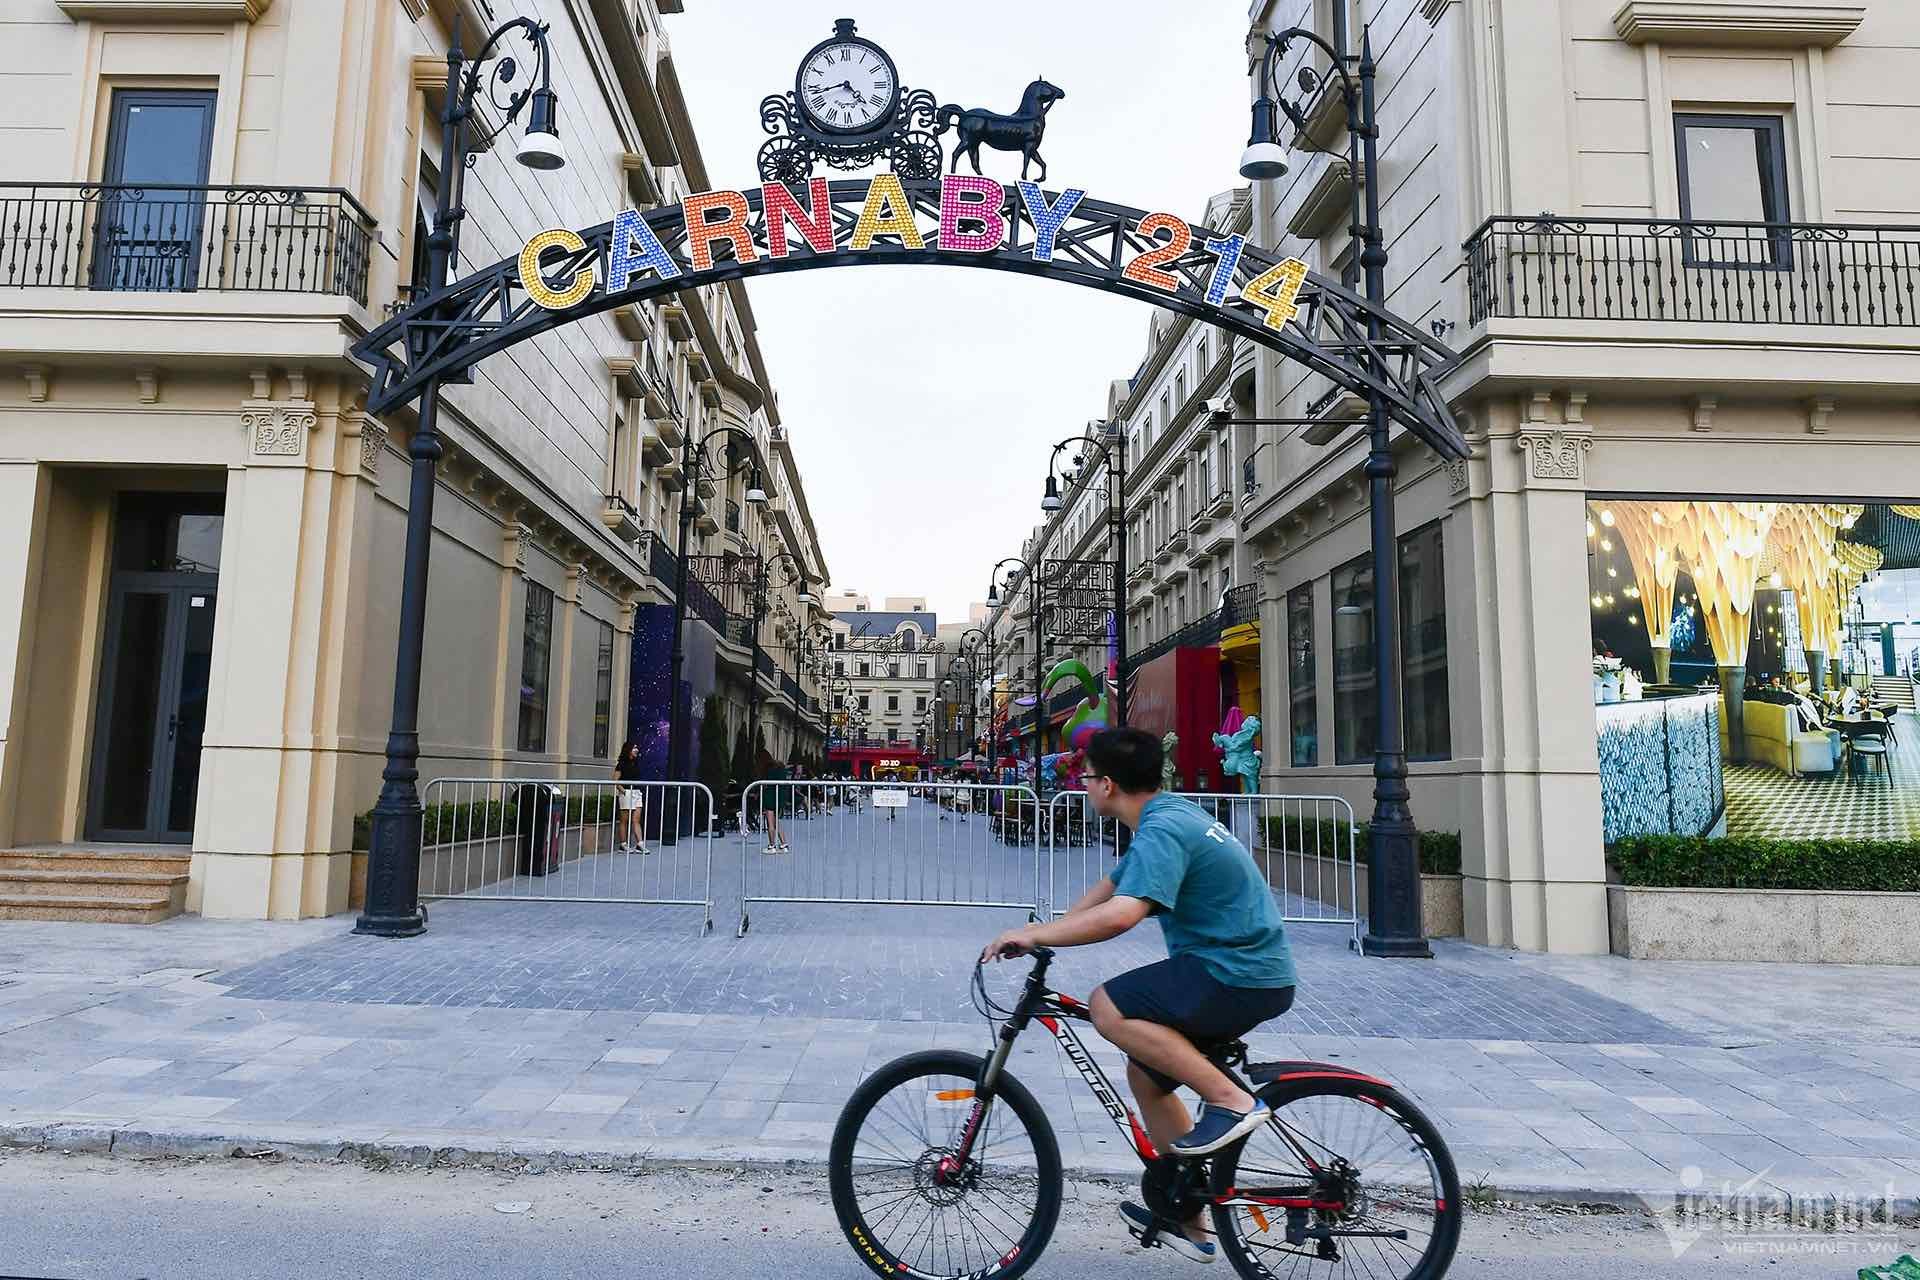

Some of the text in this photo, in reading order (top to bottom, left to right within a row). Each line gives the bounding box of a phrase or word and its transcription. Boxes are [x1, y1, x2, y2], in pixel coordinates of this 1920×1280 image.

[518, 173, 1310, 333] CARNABY 214
[1057, 1029, 1124, 1125] TWITTER
[852, 1225, 896, 1274] KENDA
